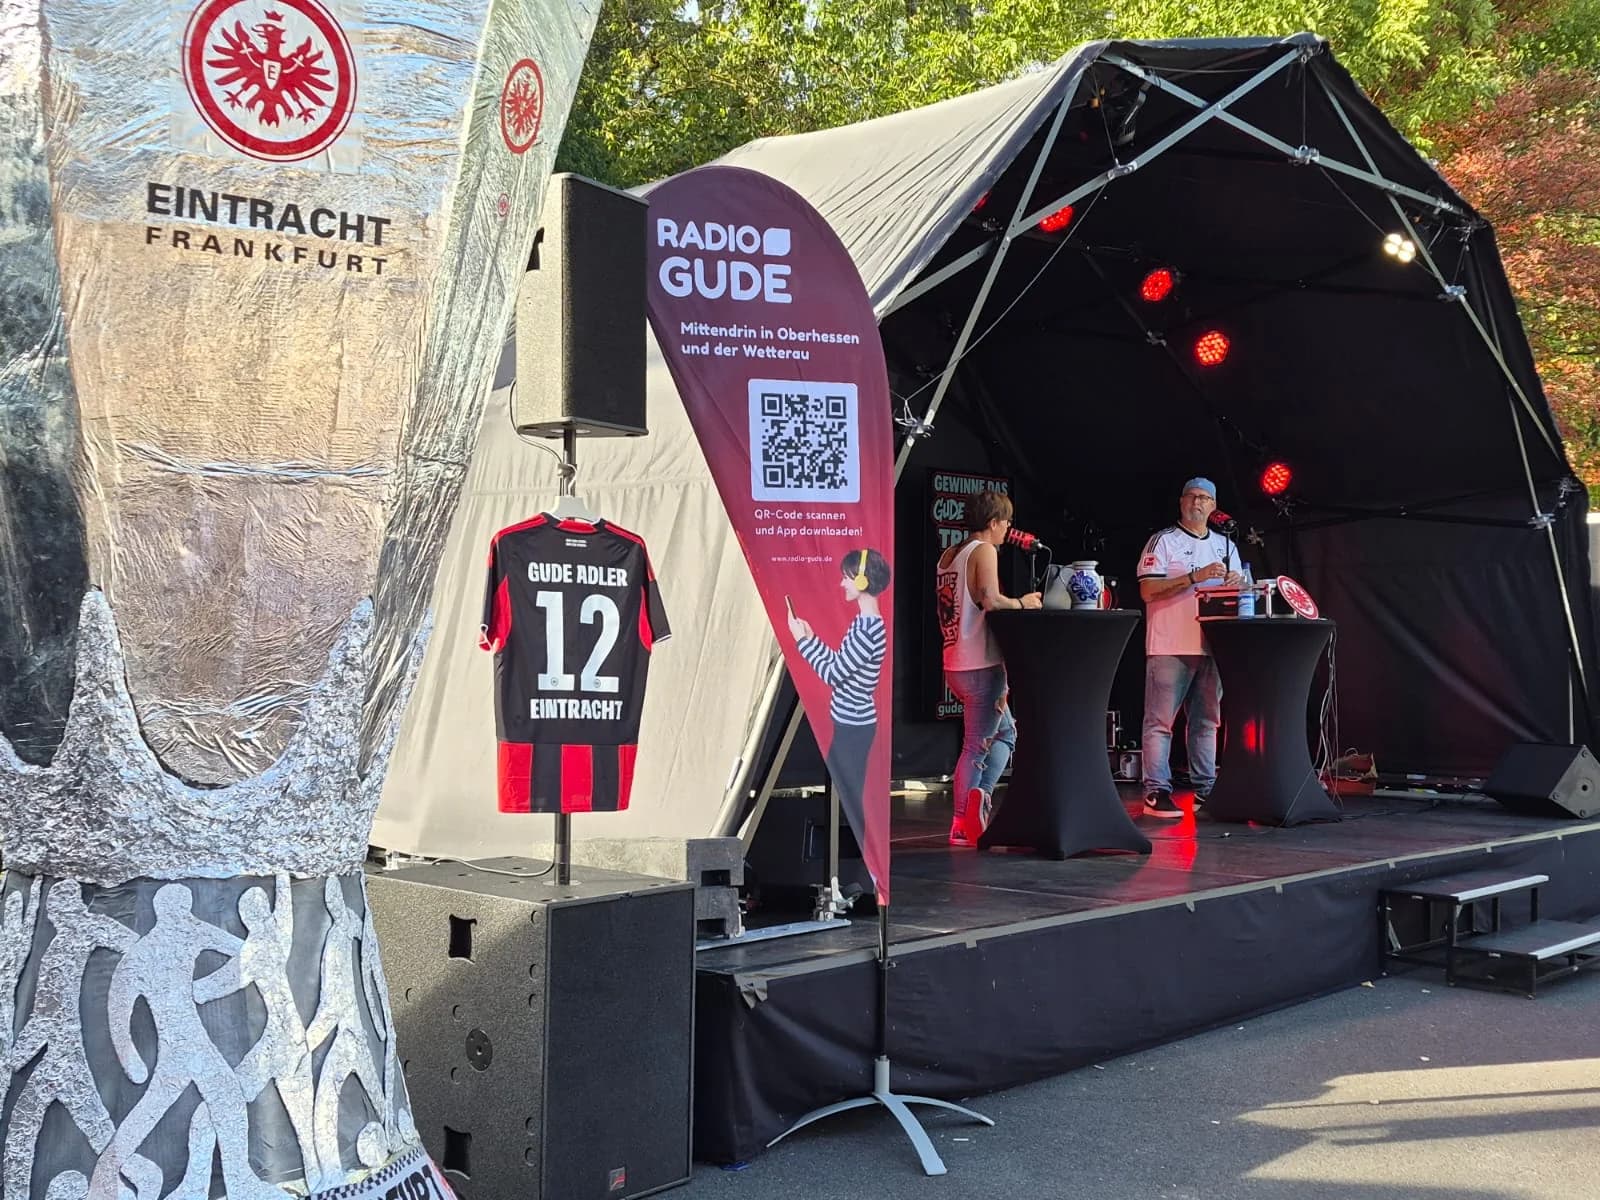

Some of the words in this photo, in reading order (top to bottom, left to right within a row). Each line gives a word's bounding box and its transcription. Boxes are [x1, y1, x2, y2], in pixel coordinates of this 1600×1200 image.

[268, 65, 276, 80] E
[147, 182, 392, 247] EINTRACHT
[657, 218, 760, 254] RADIO
[146, 227, 389, 275] FRANKFURT
[659, 256, 792, 304] GUDE
[681, 321, 757, 340] Mittendrin
[760, 324, 774, 340] in
[777, 326, 860, 346] Oberhessen
[681, 341, 711, 356] und
[714, 342, 739, 357] der
[742, 344, 810, 361] Wetterau
[934, 474, 985, 495] GEWINNE
[988, 480, 1008, 497] DAS
[754, 509, 803, 521] QR-Code
[806, 512, 846, 521] scannen
[933, 497, 965, 523] GUDE
[755, 526, 774, 536] und
[776, 526, 797, 538] App
[799, 526, 863, 537] downloaden!
[528, 561, 574, 584] GUDE
[577, 564, 628, 588] ADLER
[535, 590, 621, 693] 12
[530, 698, 624, 721] EINTRACHT
